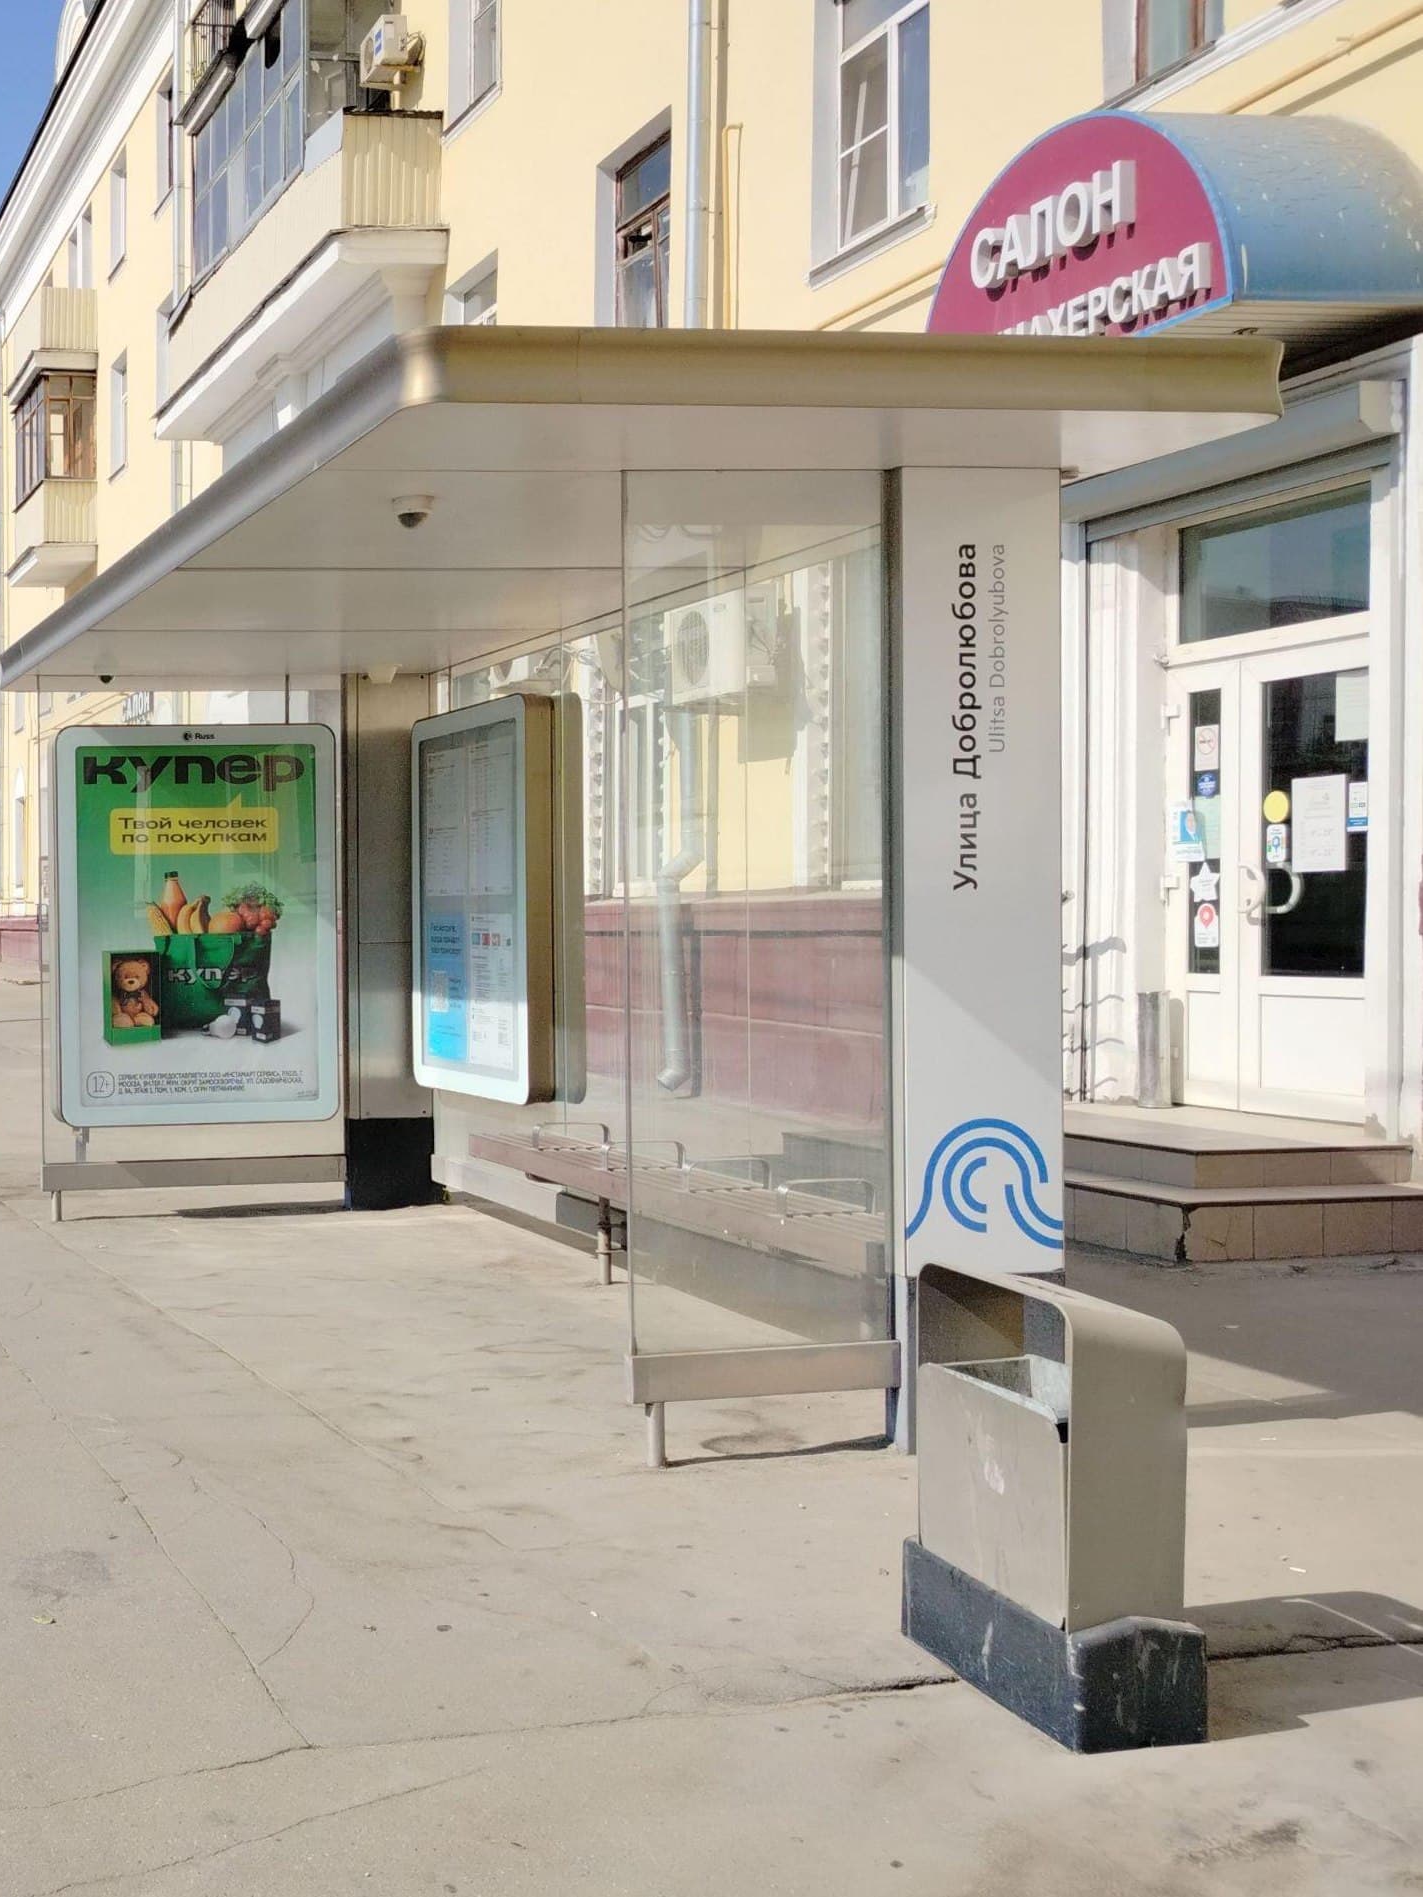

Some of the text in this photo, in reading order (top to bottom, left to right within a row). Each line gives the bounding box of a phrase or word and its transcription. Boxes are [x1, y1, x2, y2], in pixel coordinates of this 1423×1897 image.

[970, 160, 1136, 289] САЛОН
[987, 543, 1009, 753] Ulitsa Dobrolyubova
[951, 543, 982, 891] Улица Добролюбова
[195, 732, 215, 740] Russ
[83, 754, 305, 793] купер
[118, 816, 267, 830] Твой человек
[121, 832, 267, 846] по покупкам
[93, 1075, 110, 1093] 12+
